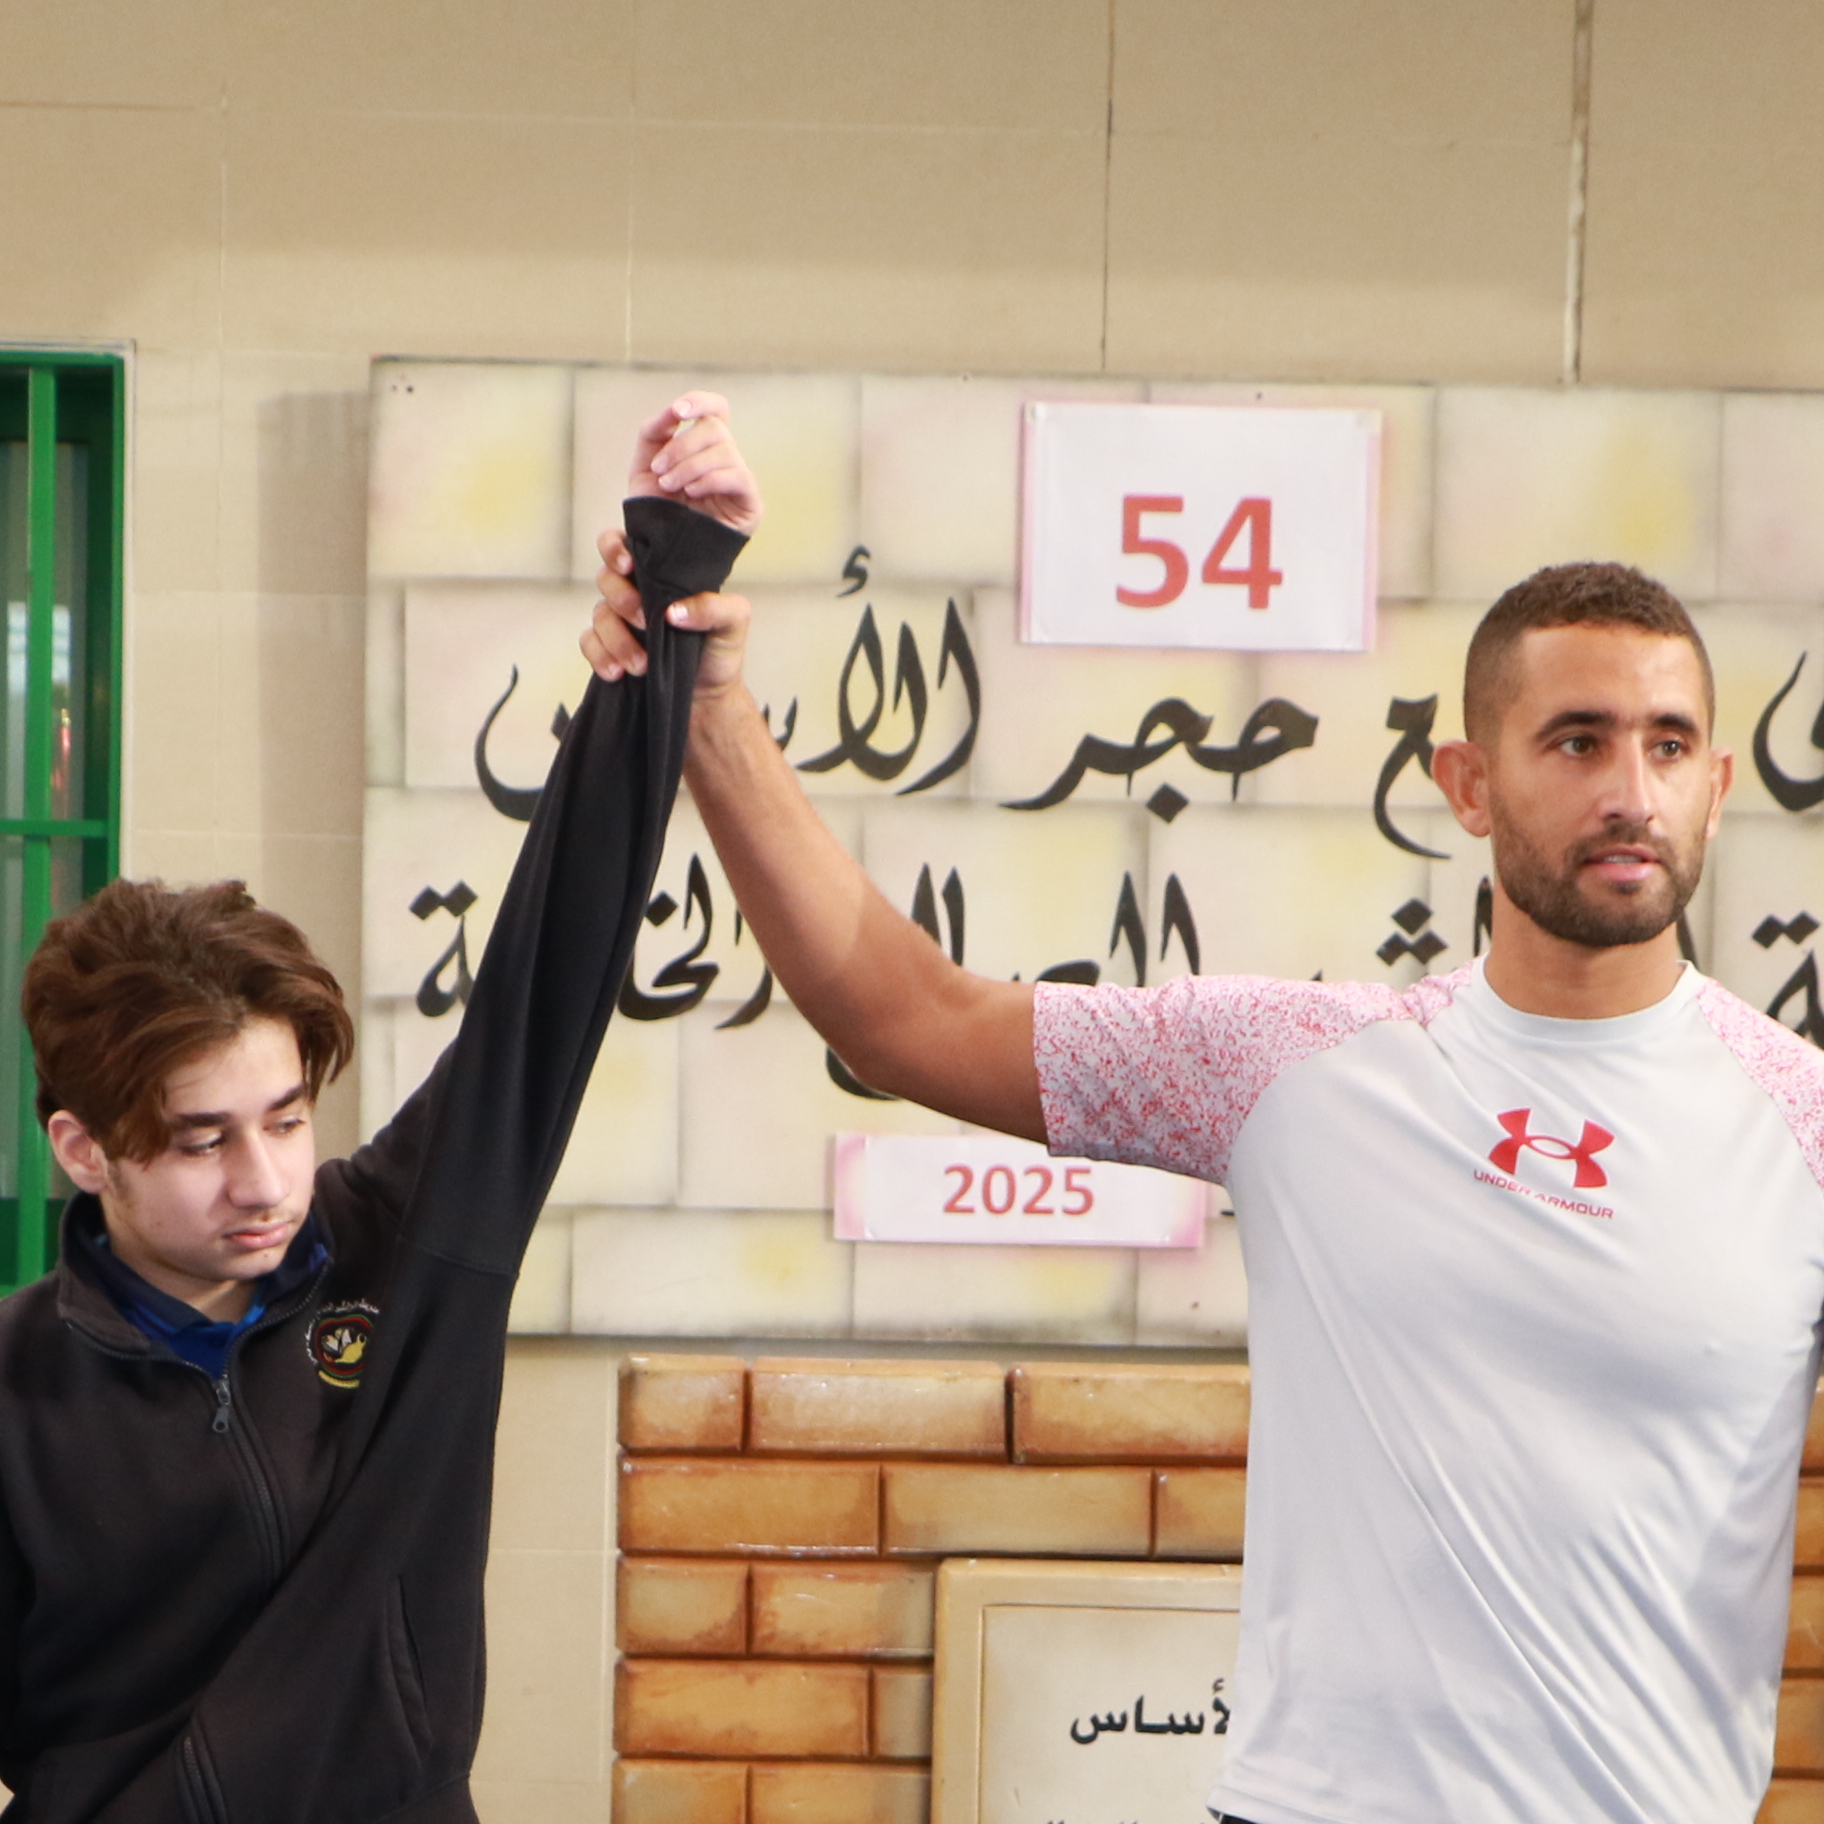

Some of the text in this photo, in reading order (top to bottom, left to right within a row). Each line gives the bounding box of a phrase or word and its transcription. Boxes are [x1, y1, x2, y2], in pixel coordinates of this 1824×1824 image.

[1113, 493, 1284, 612] 54
[999, 696, 1320, 824] حجر
[942, 1164, 1095, 1217] 2025
[1473, 1168, 1615, 1220] UNDER ARMOUR
